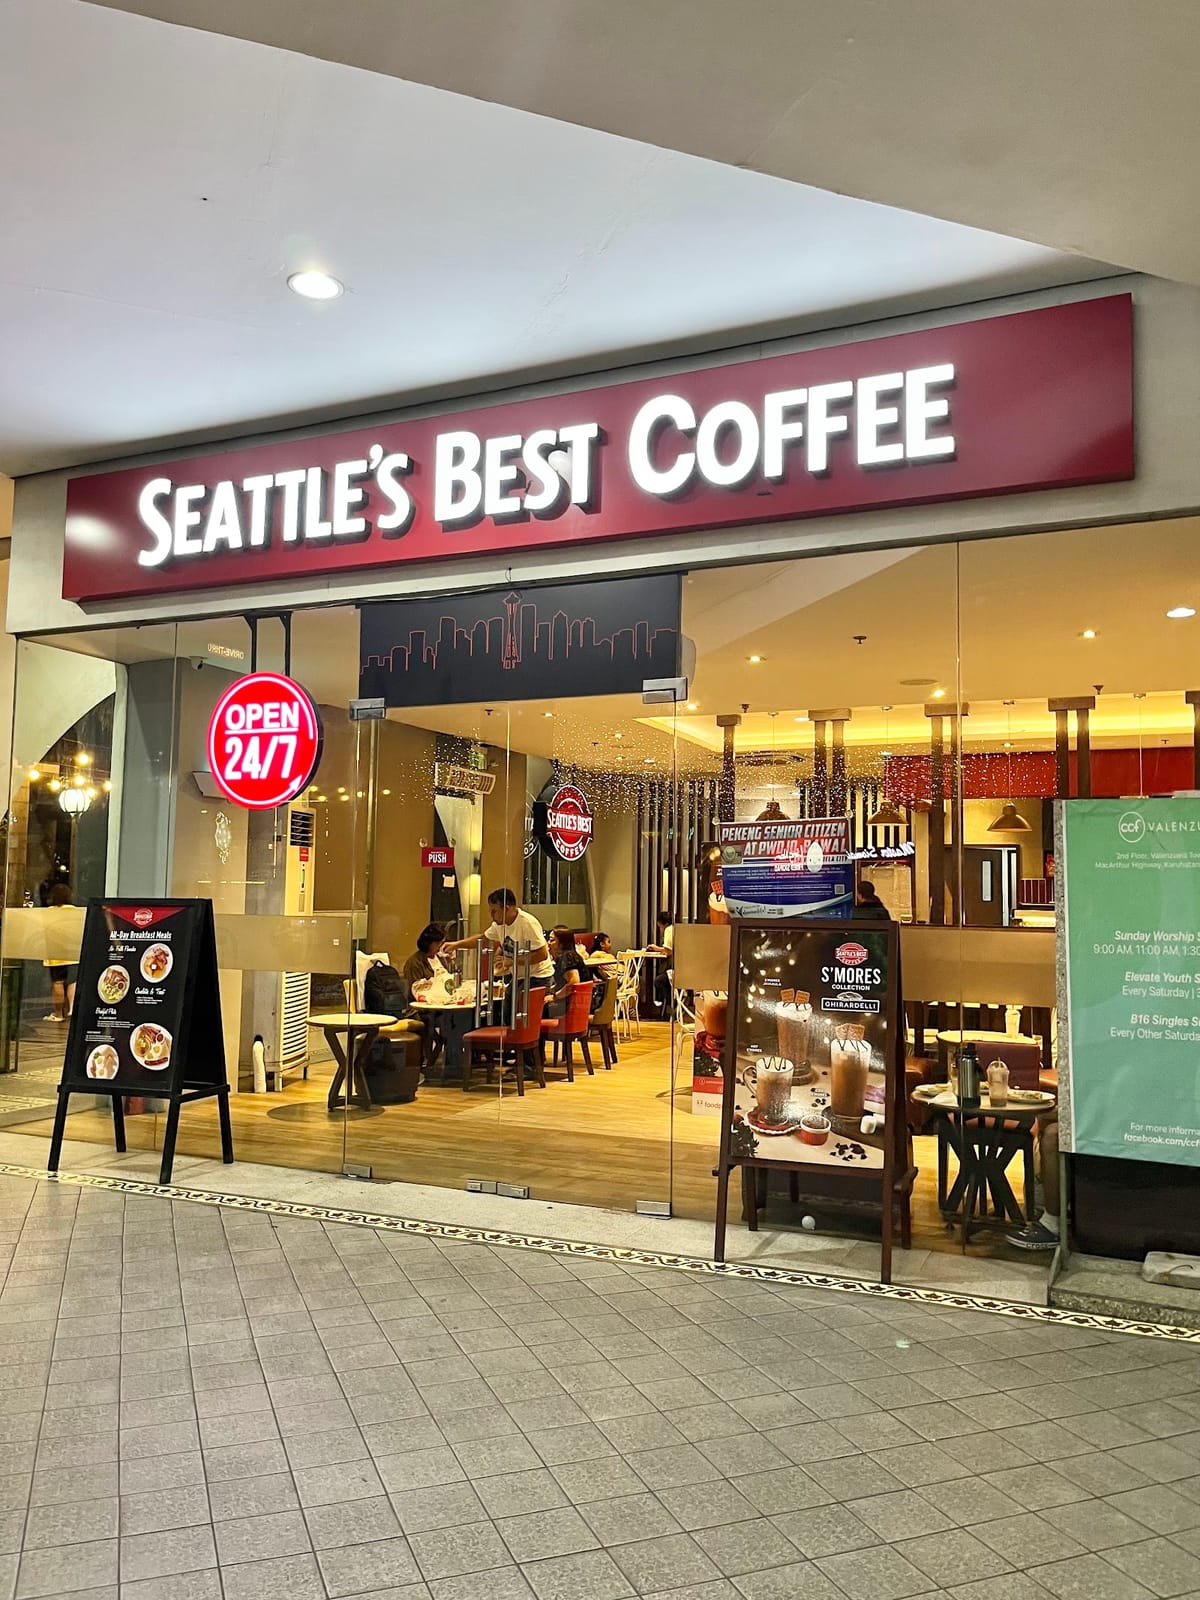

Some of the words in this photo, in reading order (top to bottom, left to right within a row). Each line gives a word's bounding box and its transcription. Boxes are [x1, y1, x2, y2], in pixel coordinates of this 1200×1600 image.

[138, 443, 409, 568] SEATTLE'S
[434, 423, 598, 524] BEST
[628, 362, 956, 496] COFFEE
[225, 701, 300, 731] OPEN
[224, 735, 298, 780] 24/7
[546, 808, 577, 831] SEATTLE'S
[577, 815, 593, 834] BEST
[1120, 819, 1141, 832] ccf
[721, 826, 762, 842] PEKENG
[764, 824, 804, 839] SENIOR
[803, 822, 846, 838] CITIZEN
[556, 838, 584, 857] COFFEE
[744, 841, 758, 856] AT
[758, 840, 785, 855] PWD
[803, 837, 846, 853] BWAL
[428, 853, 447, 864] PUSH
[130, 930, 155, 940] Breakfast
[155, 930, 172, 940] Meals
[1114, 930, 1151, 943] Sunday
[1153, 930, 1194, 944] Worship
[821, 966, 881, 985] S'MORES
[1124, 971, 1161, 983] Elevate
[1162, 971, 1192, 984] Youth
[831, 983, 871, 991] COLLECTION
[1122, 984, 1148, 998] Every
[1149, 985, 1190, 999] Saturday
[824, 1000, 877, 1011] GHIRARDELLI
[1130, 1013, 1150, 1025] B16
[1152, 1014, 1189, 1028] Singles
[1110, 1027, 1136, 1040] Every
[1137, 1027, 1163, 1040] Other
[1130, 1122, 1144, 1131] For
[1145, 1124, 1168, 1133] more
